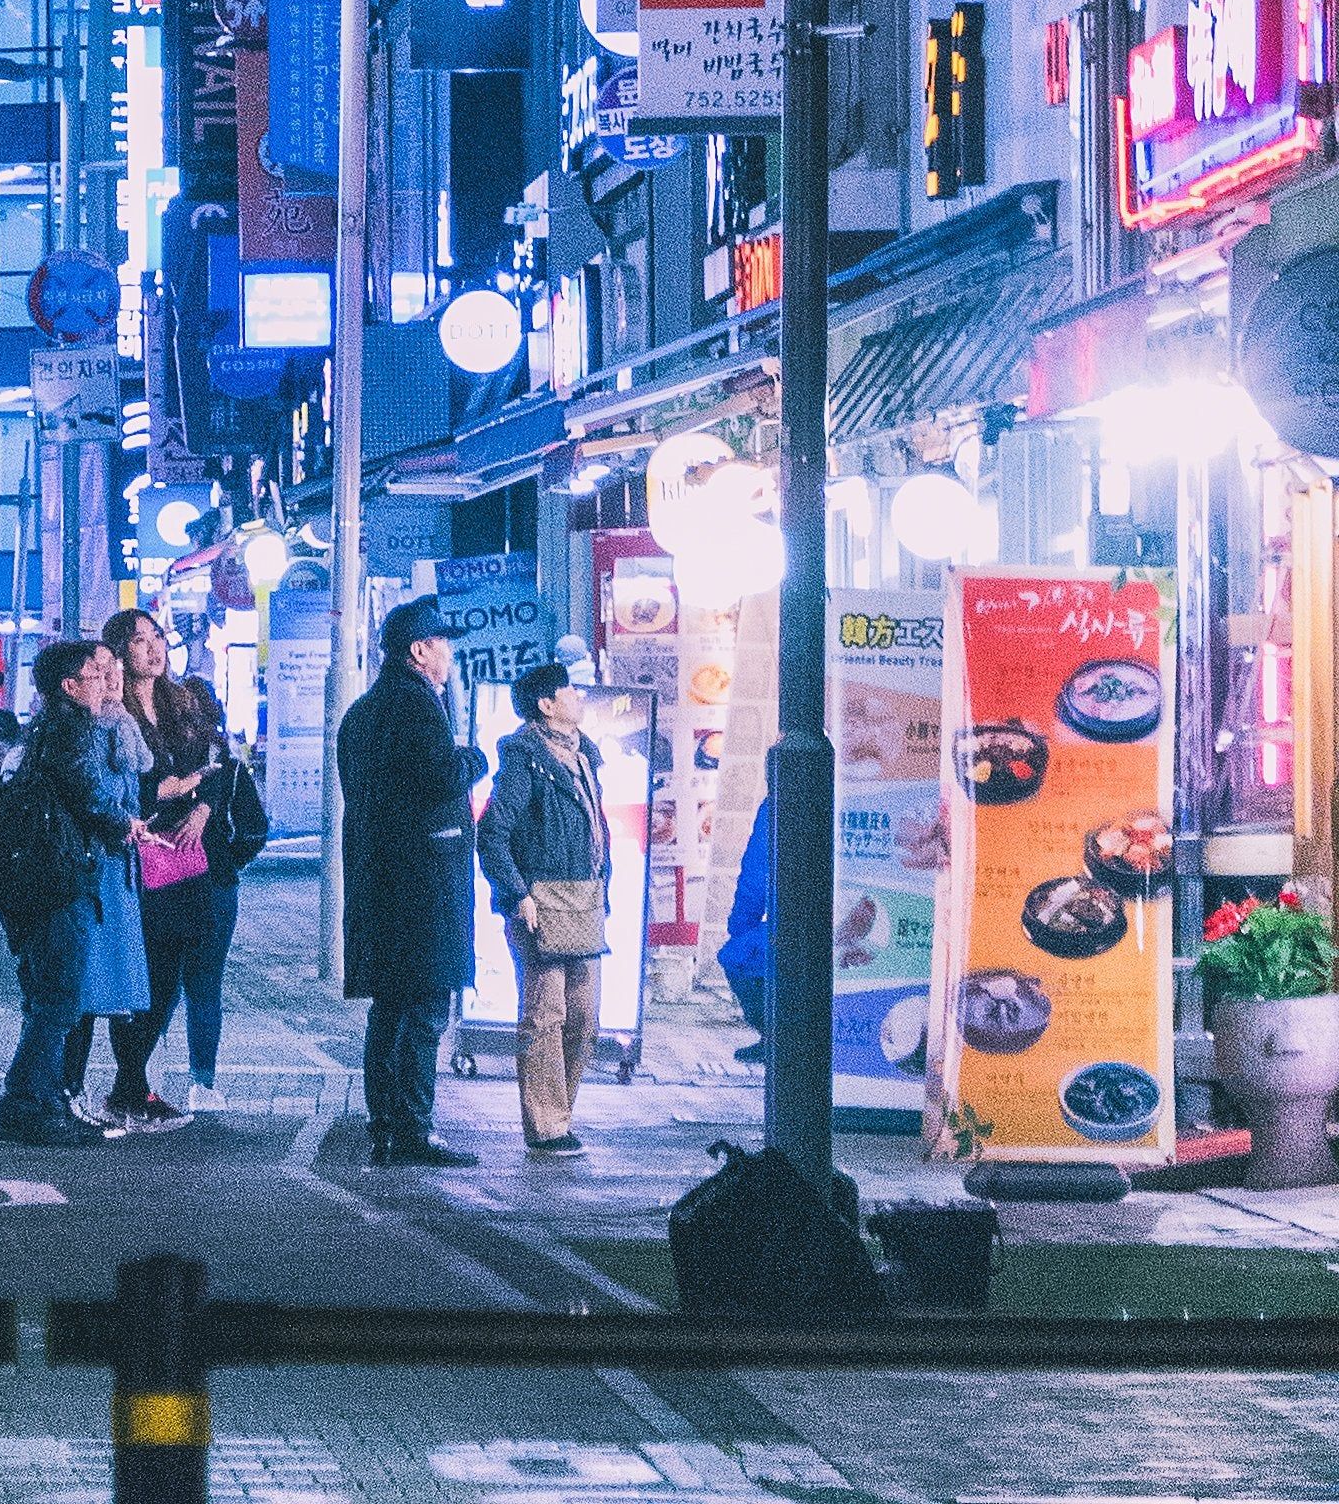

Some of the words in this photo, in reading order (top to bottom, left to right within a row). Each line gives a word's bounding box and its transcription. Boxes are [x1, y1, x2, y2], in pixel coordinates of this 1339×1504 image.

[444, 599, 540, 631] TOMO
[839, 613, 945, 650] 韓方エス
